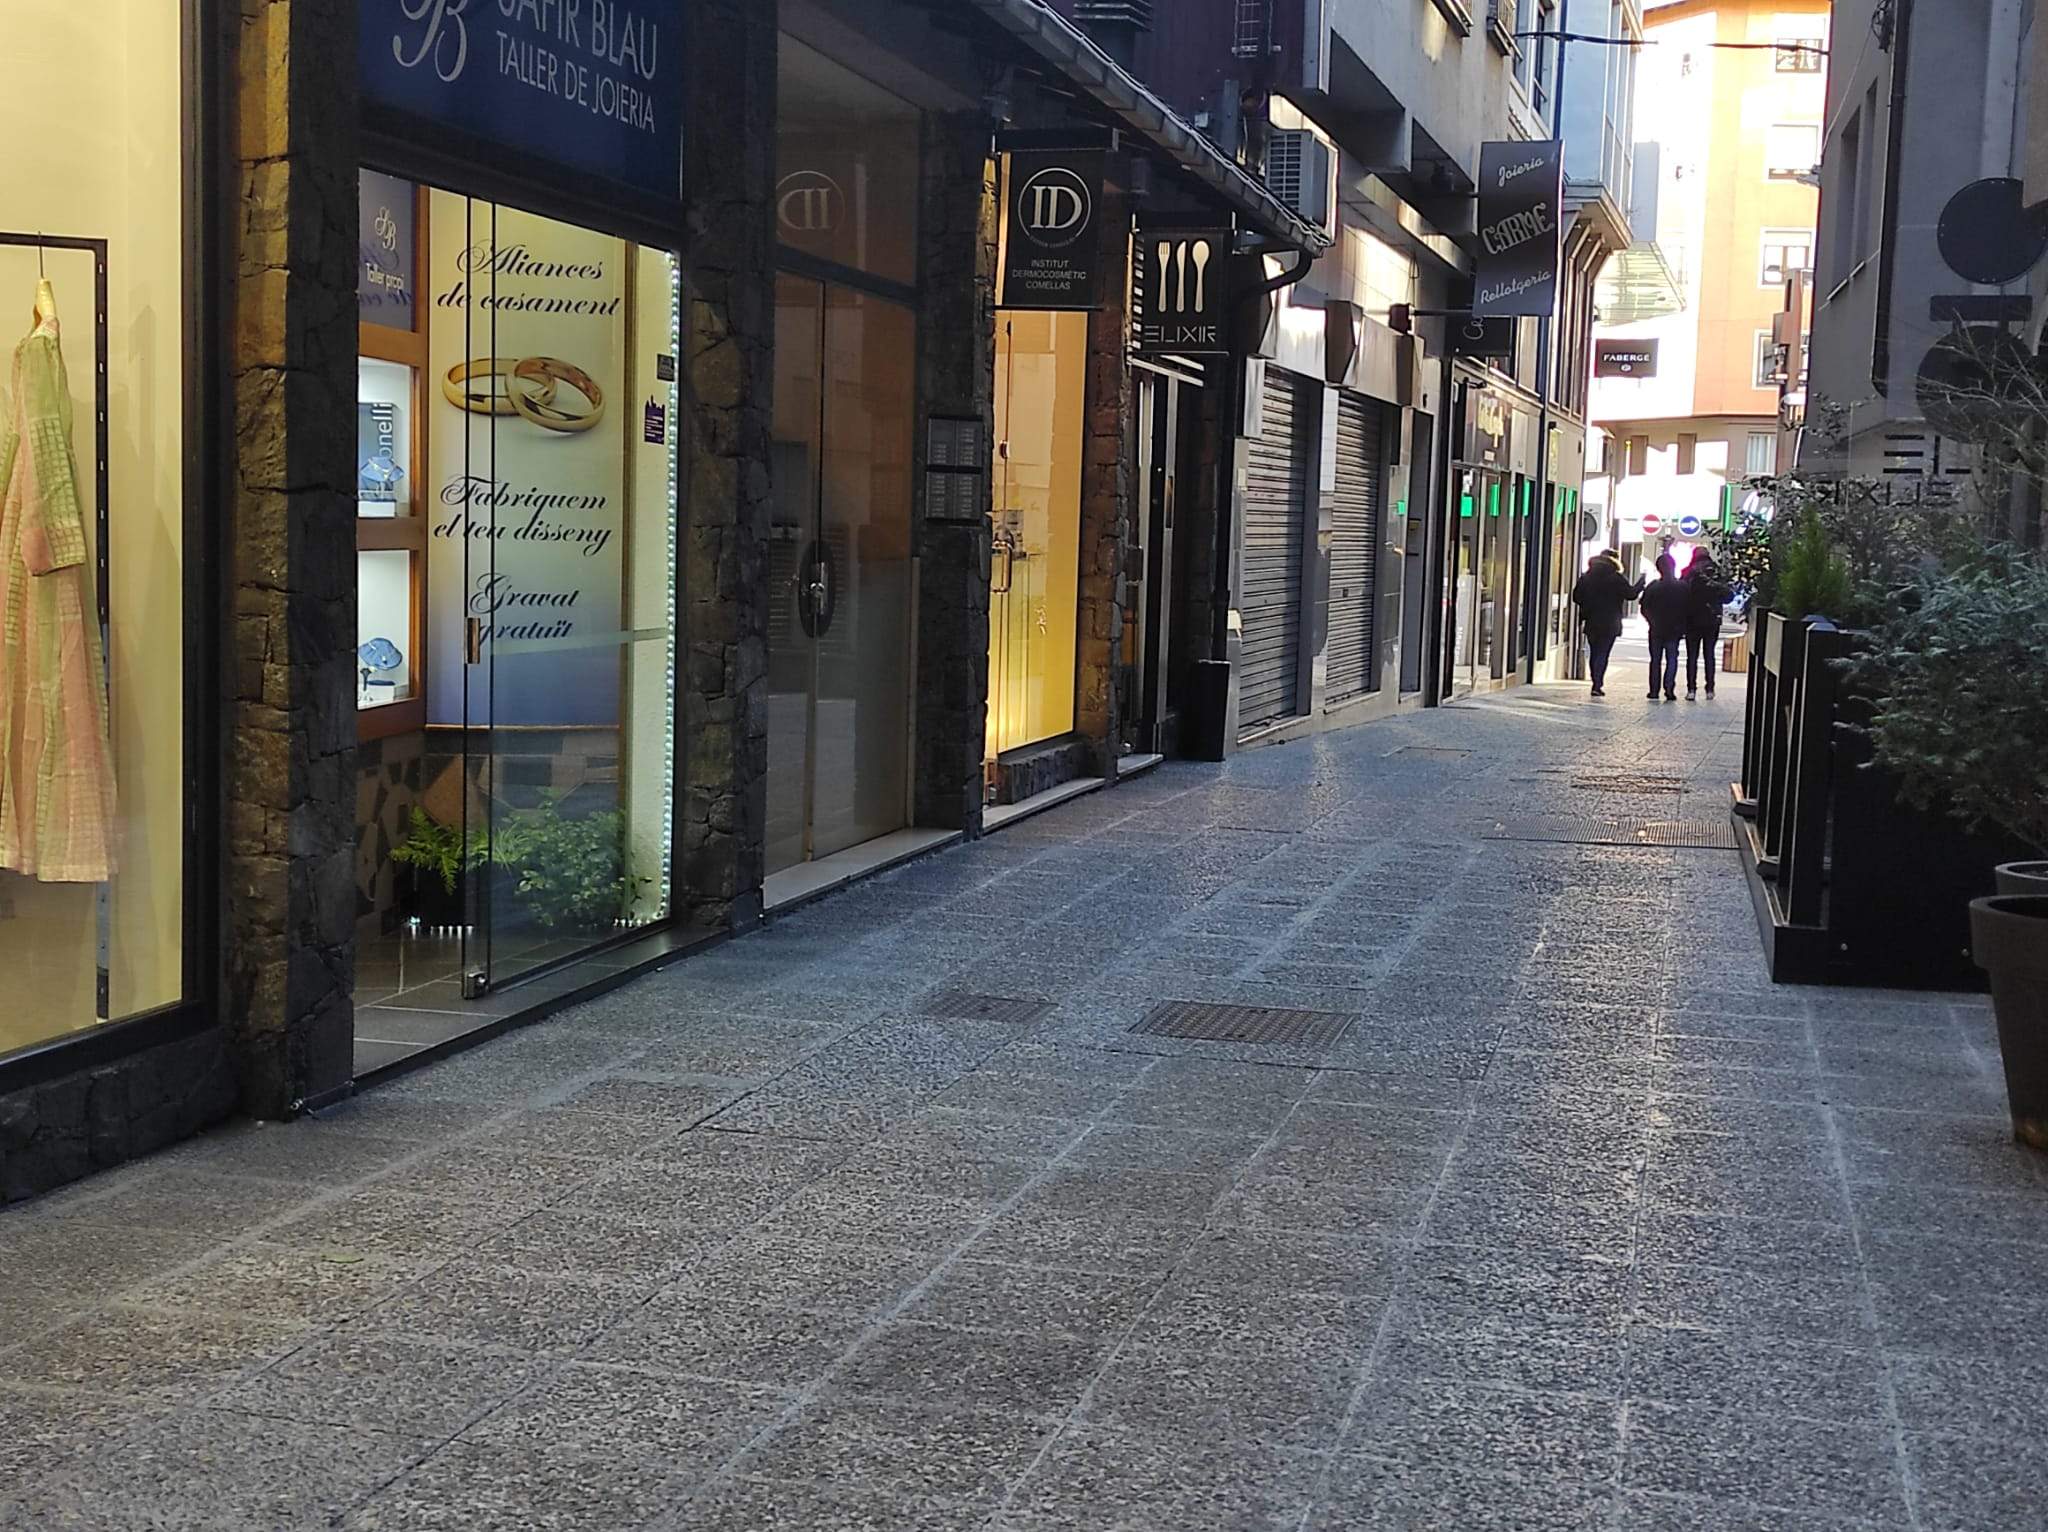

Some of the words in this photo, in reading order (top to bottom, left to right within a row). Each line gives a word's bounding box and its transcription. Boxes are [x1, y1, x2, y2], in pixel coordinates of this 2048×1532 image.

[591, 0, 657, 80] BLAU
[496, 30, 558, 95] TALLER
[564, 60, 588, 107] DE
[591, 73, 656, 133] JOIERIA
[1498, 156, 1545, 187] Joieria
[1030, 185, 1083, 229] ID
[457, 239, 603, 280] Aliances
[1031, 259, 1069, 268] INSTITUT
[437, 281, 473, 309] de
[480, 289, 621, 316] casament
[1025, 281, 1072, 290] COMELLAS
[1480, 270, 1552, 305] Rellotgeria
[440, 474, 608, 518] Fabriquem
[433, 513, 463, 540] el
[463, 520, 507, 541] teu
[513, 510, 613, 557] disseny
[470, 572, 581, 615] Gravat
